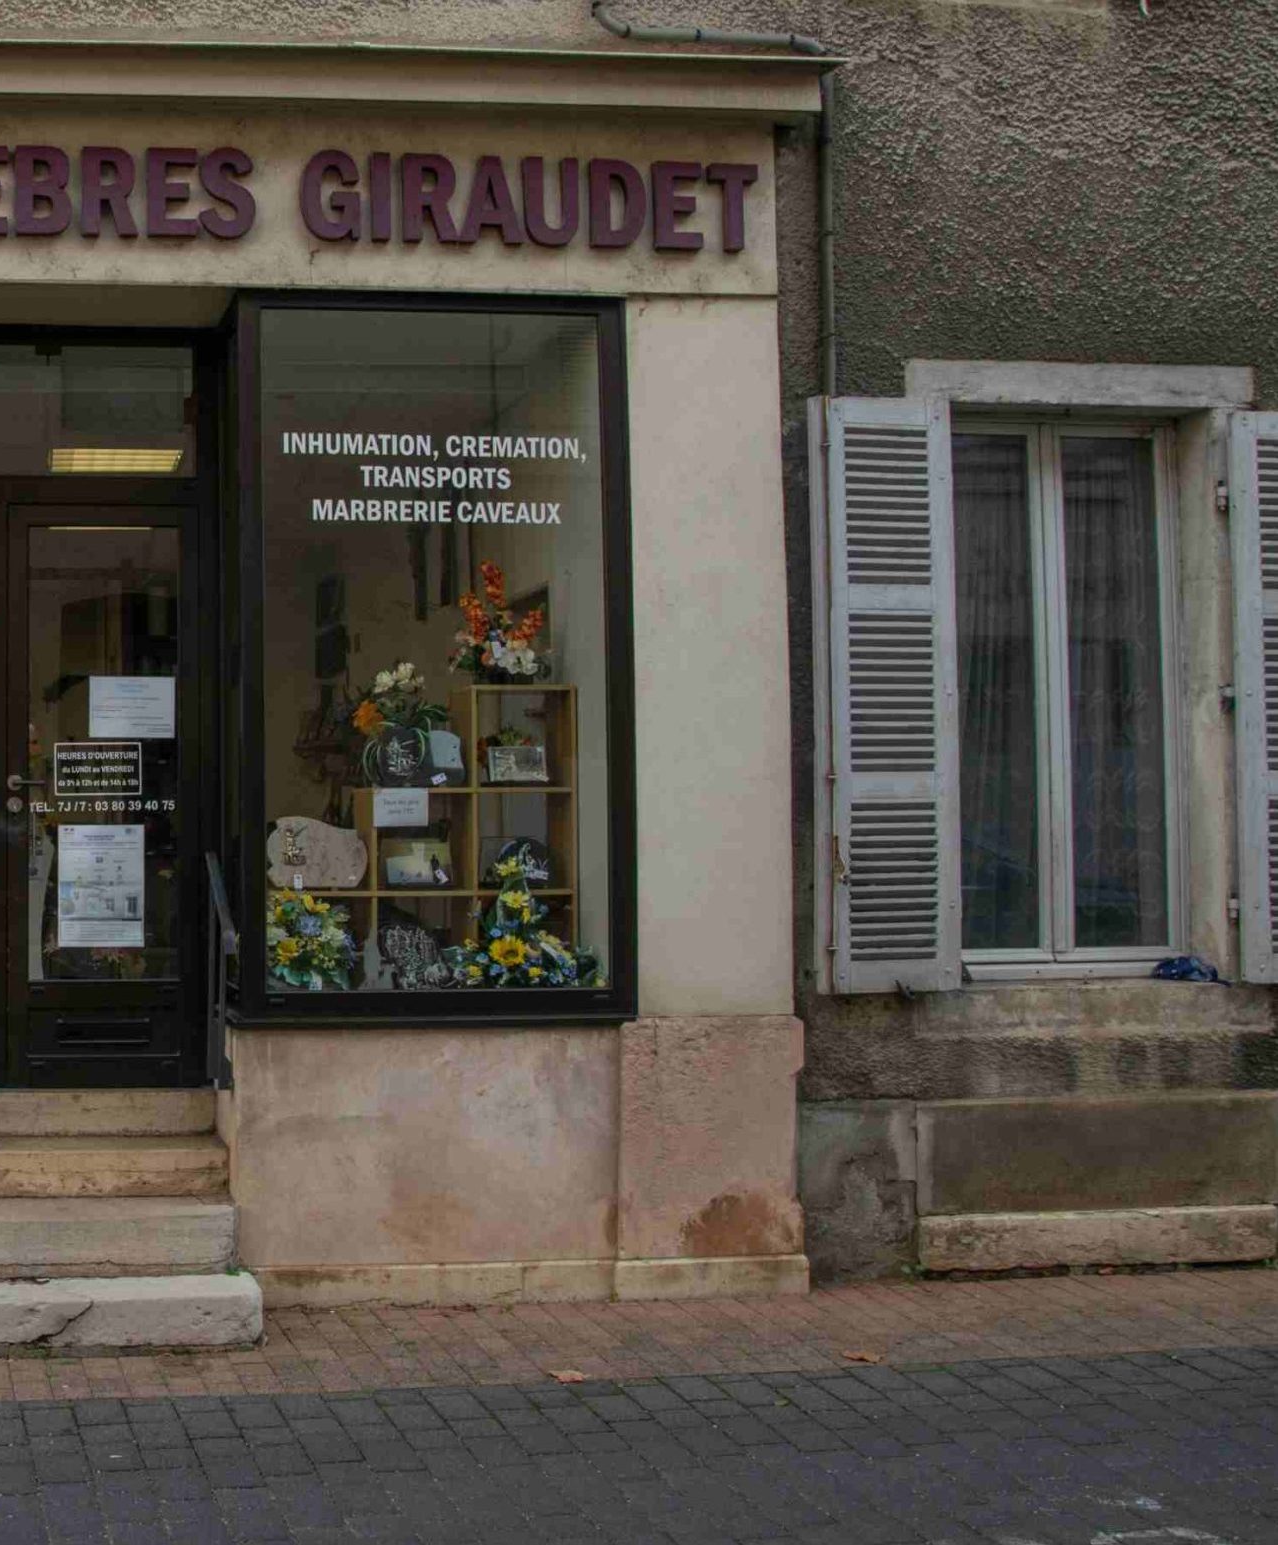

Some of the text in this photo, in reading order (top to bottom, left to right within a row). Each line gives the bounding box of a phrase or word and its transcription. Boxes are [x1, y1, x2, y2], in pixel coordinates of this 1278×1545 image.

[299, 149, 759, 254] GIRAUDET
[281, 431, 588, 464] INHUMATION, CREMATION,
[359, 464, 512, 490] TRANSPORTS
[311, 499, 563, 525] MARBRERIE CAVEAUX
[57, 751, 139, 760] HEURES D'OUVERTURE
[71, 765, 92, 774] LUNDI
[100, 765, 135, 774] VENDREDI
[28, 800, 55, 813] TEL.
[95, 800, 109, 812] 03
[111, 800, 125, 812] 80
[128, 800, 142, 812] 39
[144, 800, 159, 812] 40
[162, 799, 176, 812] 75
